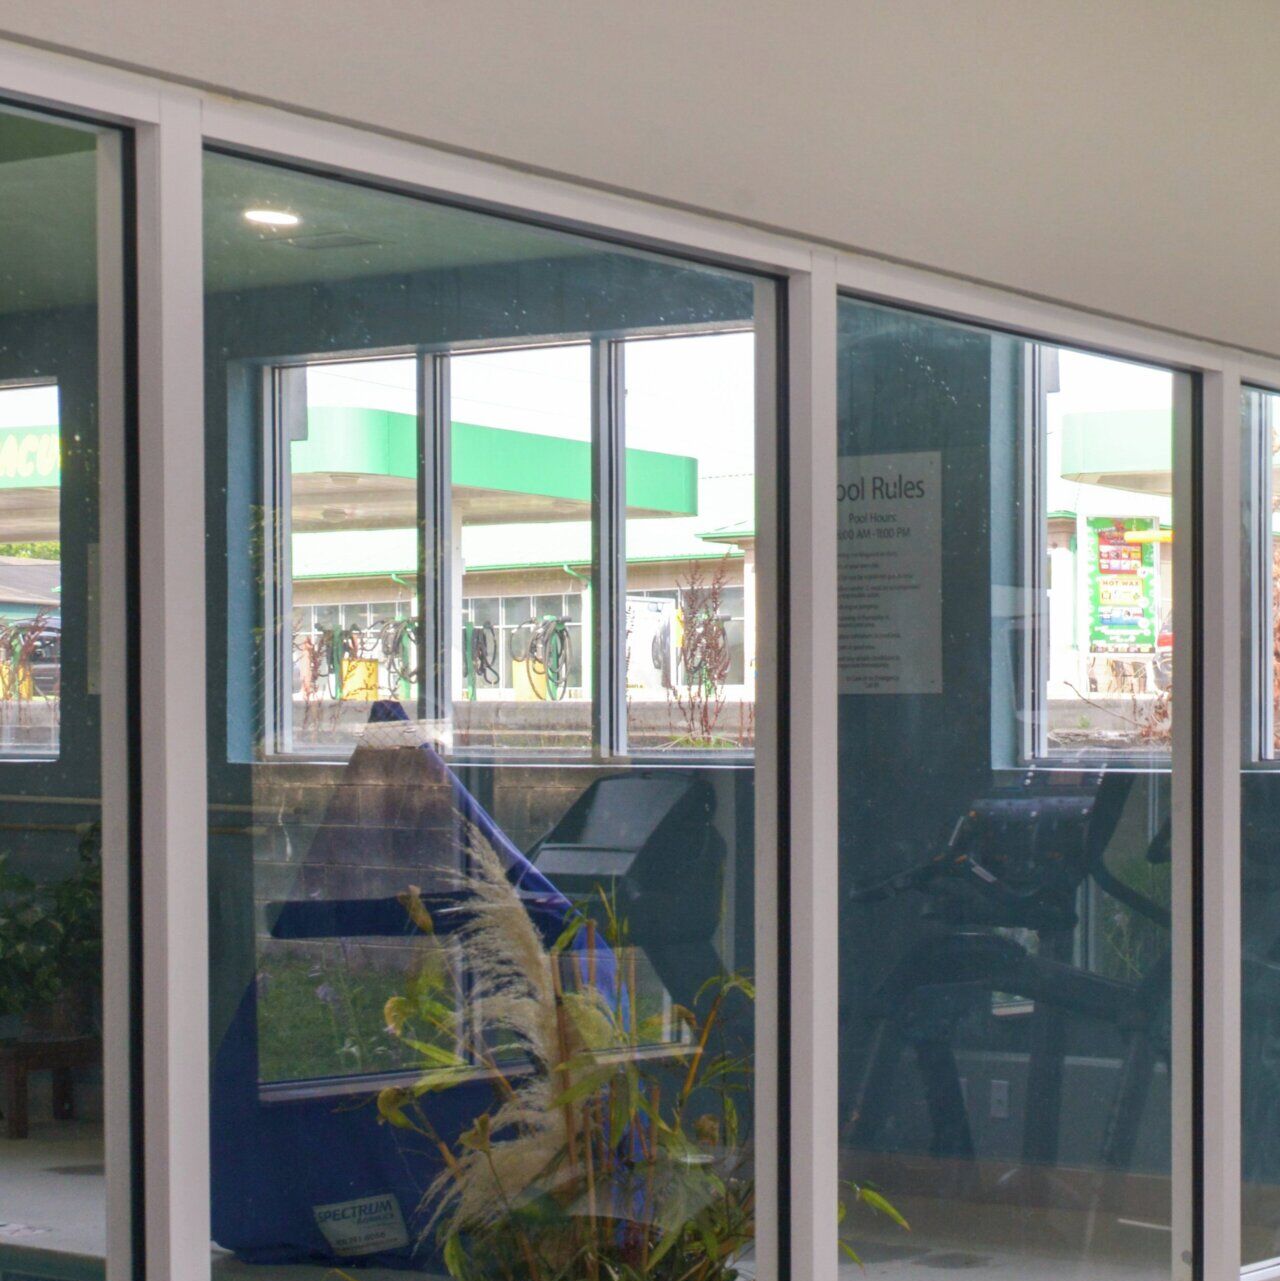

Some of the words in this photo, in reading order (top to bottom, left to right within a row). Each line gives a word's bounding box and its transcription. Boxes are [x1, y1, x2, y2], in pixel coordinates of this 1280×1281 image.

[837, 476, 865, 501] ool
[872, 474, 925, 500] Rules
[319, 1200, 393, 1222] SPECTRUM
